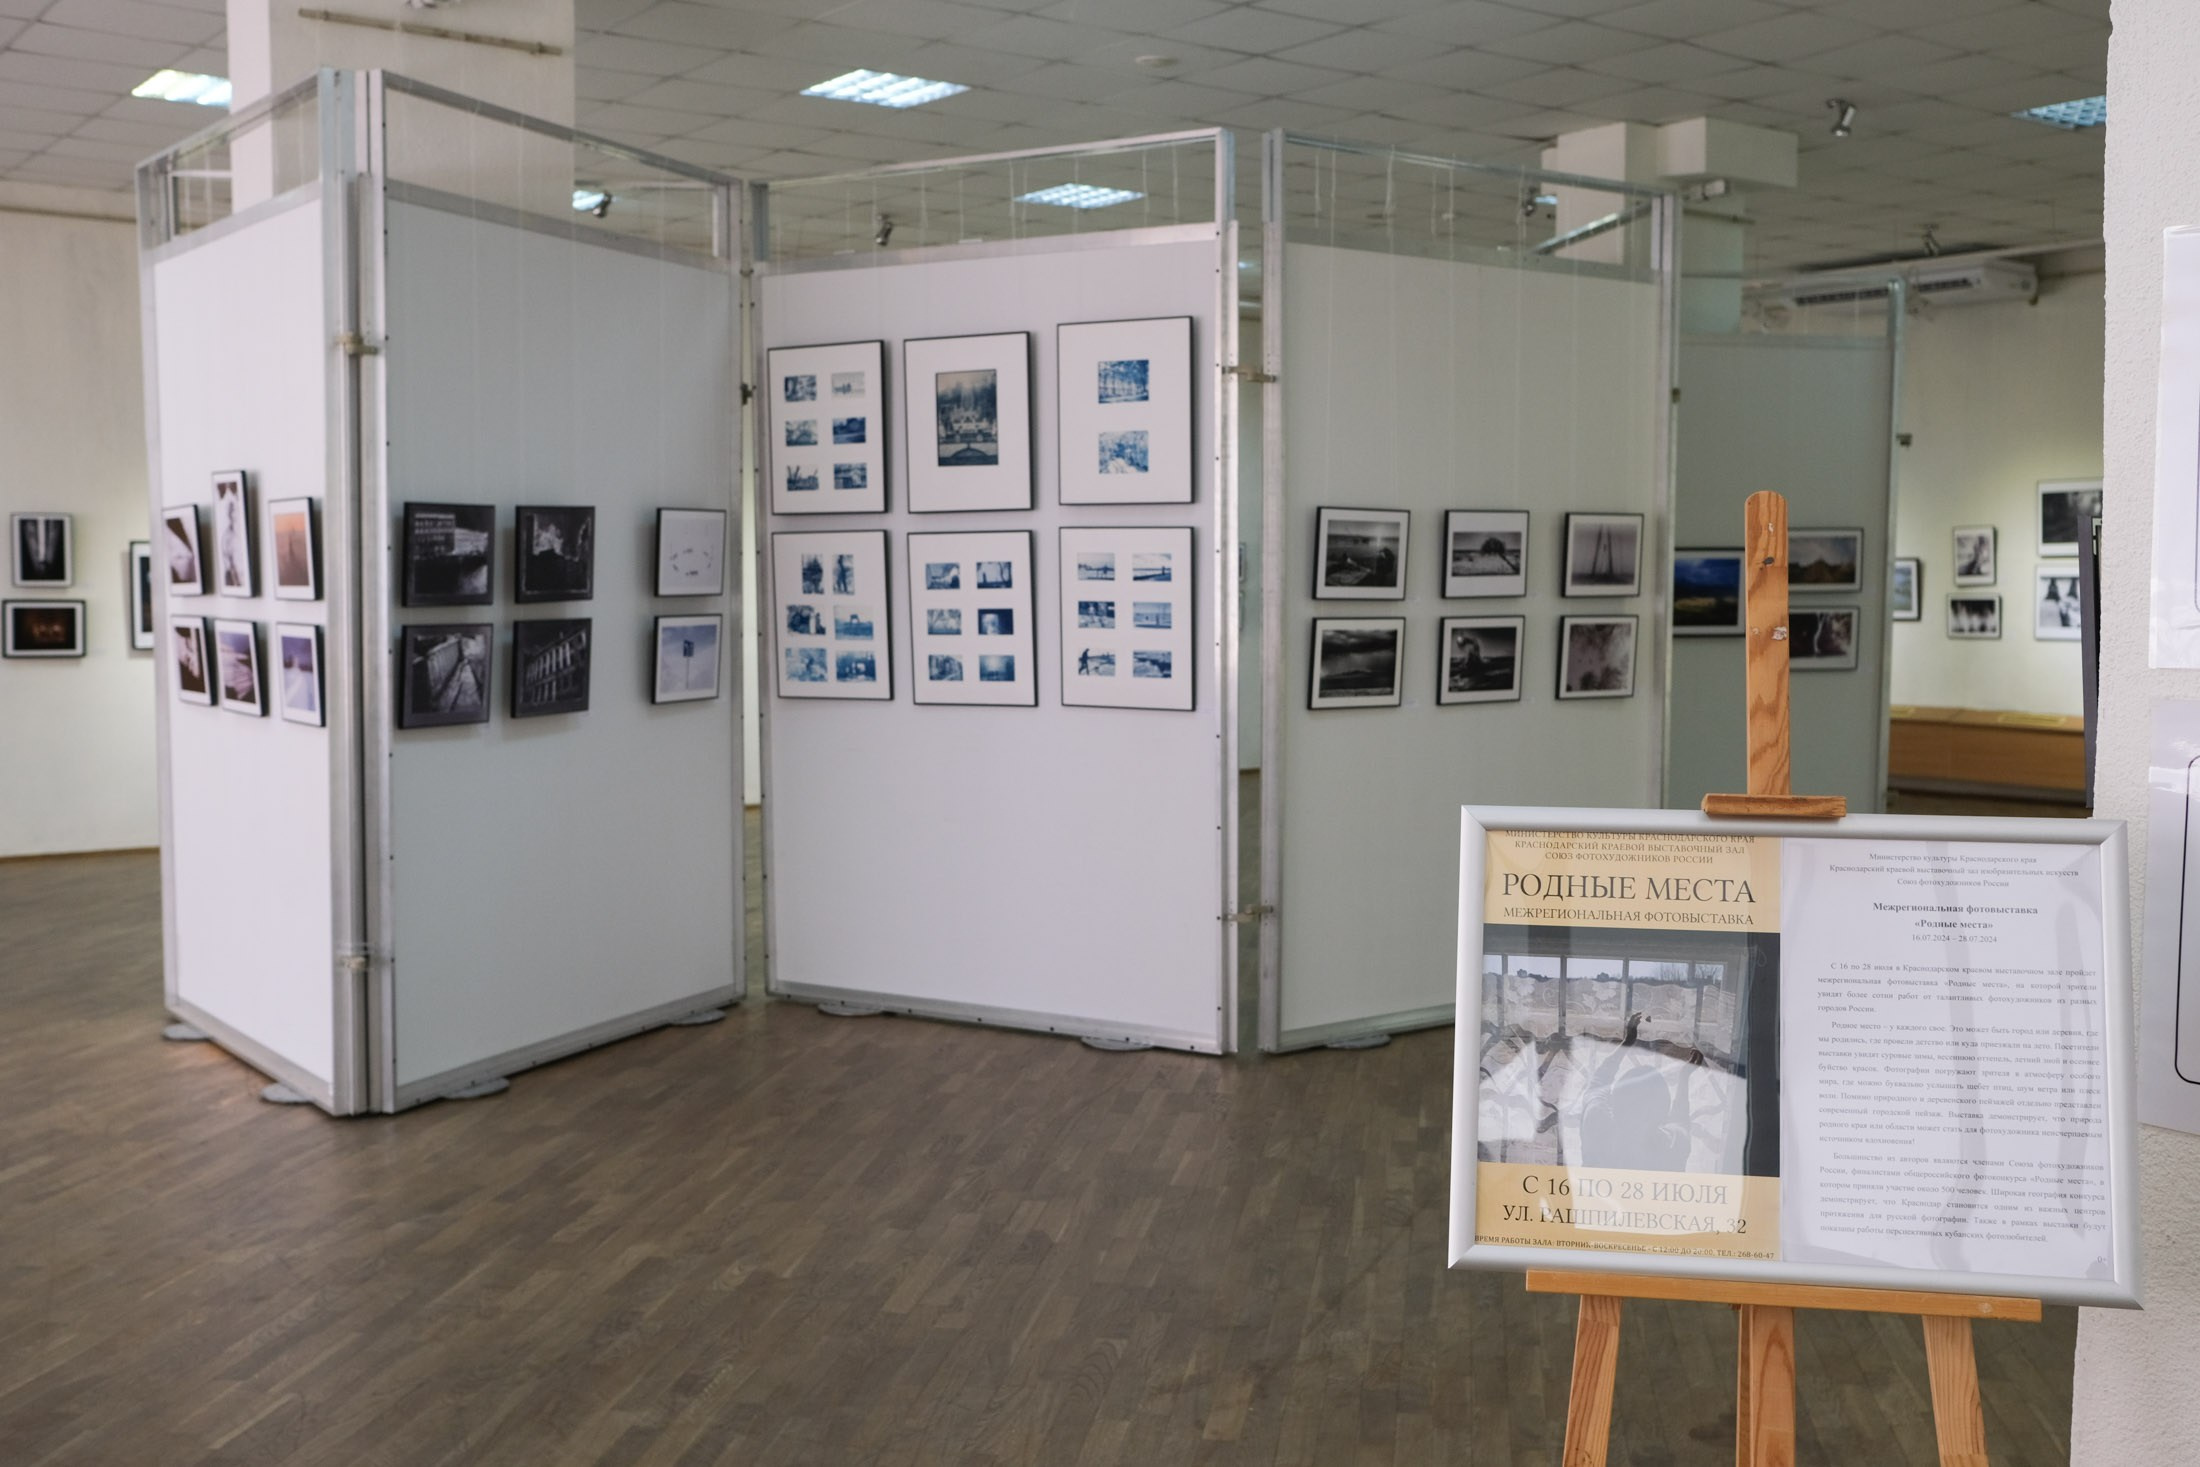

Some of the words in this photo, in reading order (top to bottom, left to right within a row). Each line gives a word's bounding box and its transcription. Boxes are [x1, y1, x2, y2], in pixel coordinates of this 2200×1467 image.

[1586, 831, 1636, 841] КУЛЬТУРЫ
[1730, 835, 1755, 844] КРАЯ
[1515, 840, 1599, 850] КРАСНОДАРСКИЙ
[1601, 842, 1645, 852] КРАЕВОЙ
[1648, 844, 1723, 854] ВЫСТАВОЧНЫЙ
[1726, 846, 1745, 855] ЗАЛ
[1545, 851, 1574, 860] СОЮЗ
[1575, 852, 1671, 863] ФОТОХУДОЖНИКОВ
[1673, 855, 1713, 864] РОССИИ
[1502, 872, 1636, 901] РОДНЫЕ
[1645, 877, 1756, 903] МЕСТА
[1503, 906, 1641, 921] МЕЖРЕГИОНАЛЬНАЯ
[1644, 911, 1754, 925] ФОТОВЫСТАВКА
[1871, 902, 1963, 913] Межрегиональная
[1965, 904, 2038, 915] фотовыставка
[1914, 919, 1957, 928] «Родные
[1522, 1175, 1539, 1194] С
[1548, 1177, 1570, 1196] 16
[1578, 1178, 1613, 1199] ПО
[1621, 1182, 1644, 1200] 28
[1651, 1182, 1728, 1205] ИЮЛЯ
[1503, 1204, 1533, 1222] УЛ.
[1540, 1207, 1720, 1235] РАШПИЛЕВСКАЯ,
[1727, 1217, 1747, 1234] 32
[1474, 1235, 1500, 1244] ВРЕМЯ
[1501, 1236, 1531, 1245] РАБОТЫ
[1532, 1238, 1555, 1246] ЗАЛА:
[1738, 1251, 1775, 1259] 268-60-47
